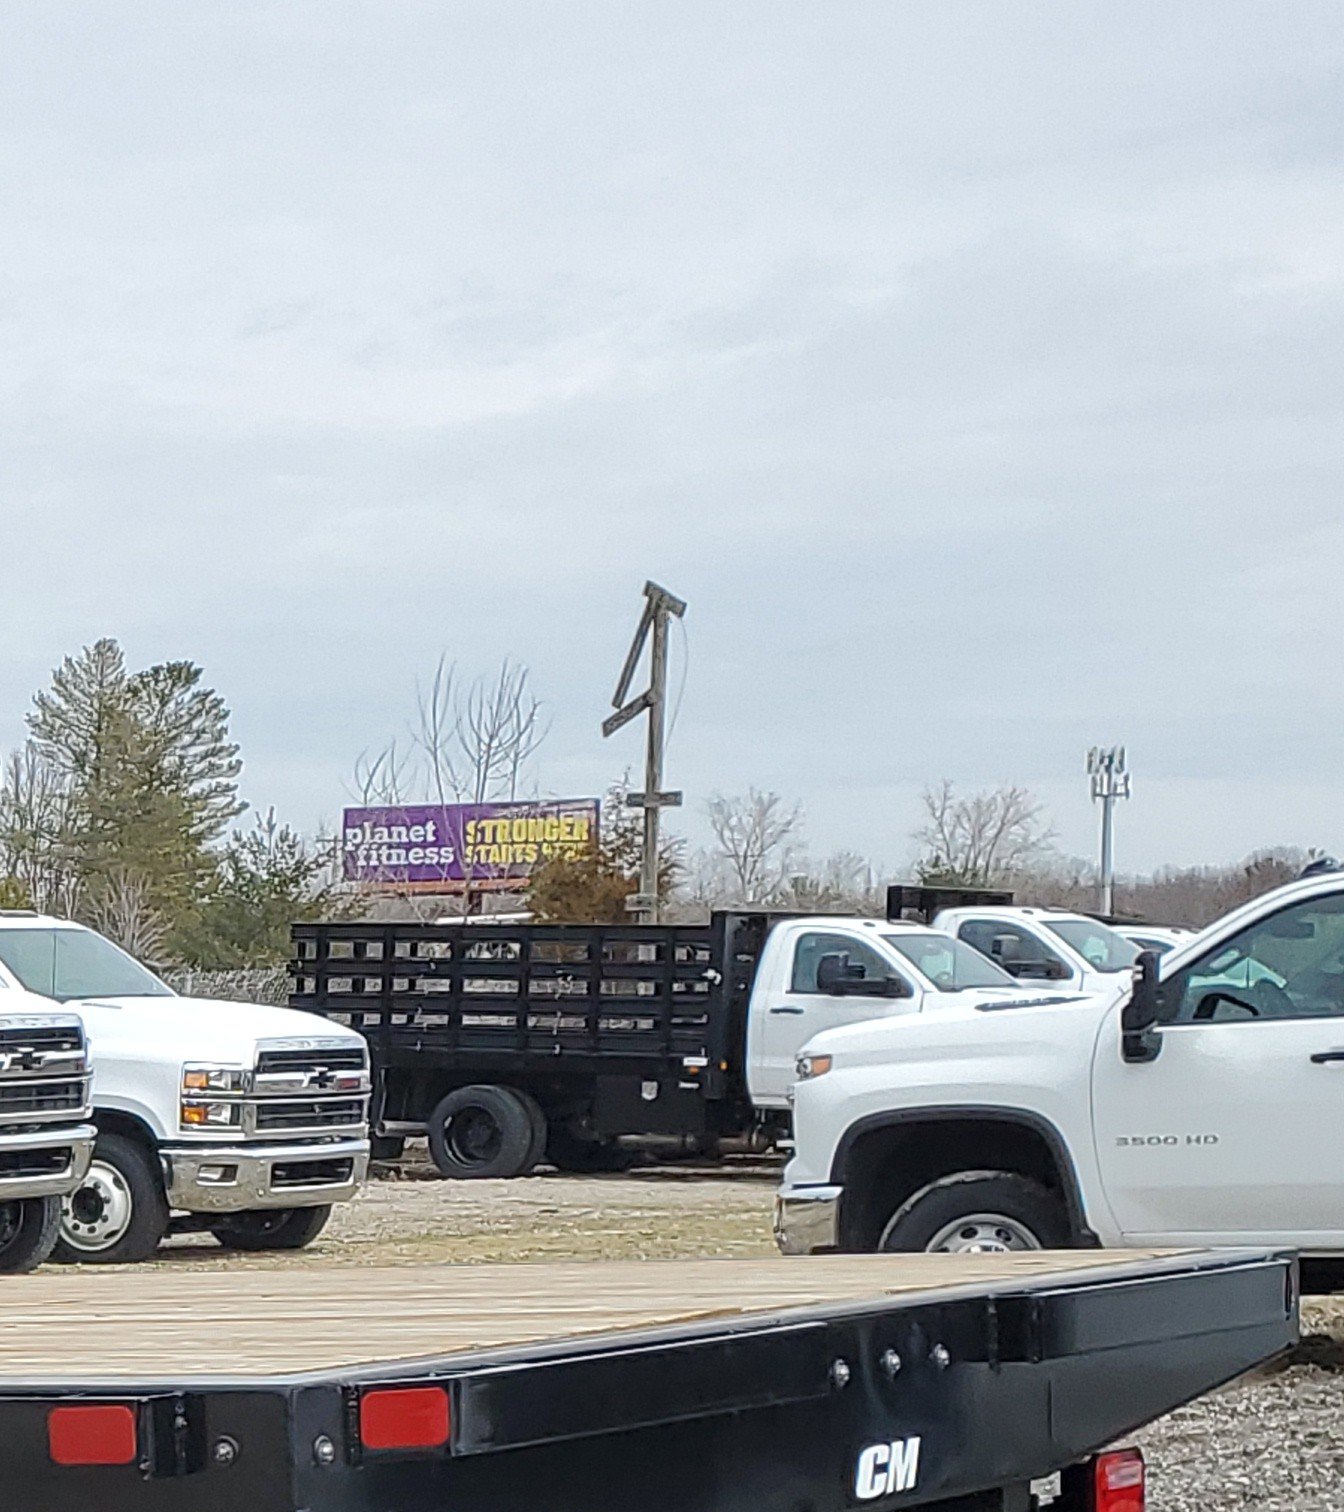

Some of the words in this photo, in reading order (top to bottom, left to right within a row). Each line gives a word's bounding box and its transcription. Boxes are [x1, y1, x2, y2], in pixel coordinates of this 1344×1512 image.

[344, 820, 437, 851] planet
[465, 814, 589, 844] STRONGER
[356, 843, 455, 866] fitness
[465, 843, 539, 865] STARTS
[1115, 1135, 1179, 1147] 3500
[1185, 1134, 1219, 1145] HD
[855, 1436, 921, 1499] CM
